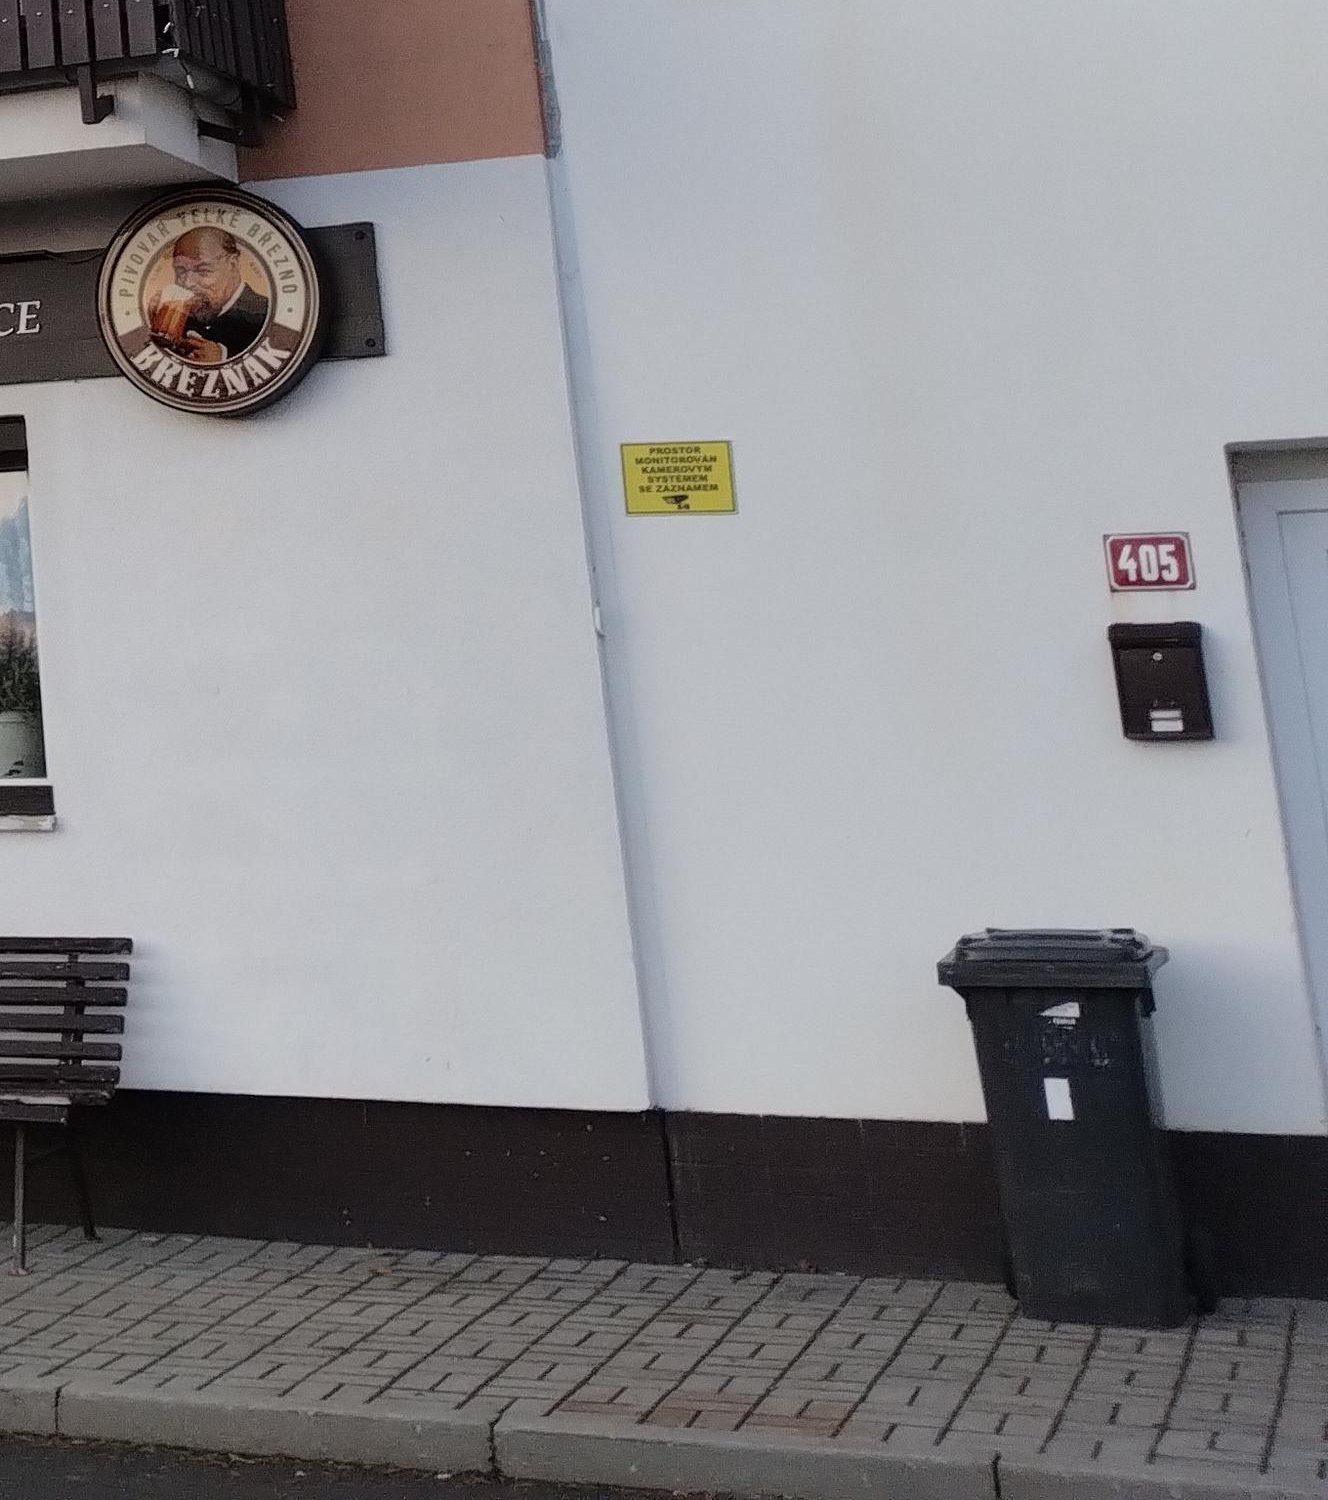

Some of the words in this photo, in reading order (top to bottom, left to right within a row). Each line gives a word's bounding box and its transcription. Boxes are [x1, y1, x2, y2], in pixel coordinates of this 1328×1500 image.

[119, 218, 170, 297] PIVOVAR
[648, 446, 702, 455] PROSTOR
[638, 484, 653, 493] SE
[1117, 544, 1180, 582] 405
